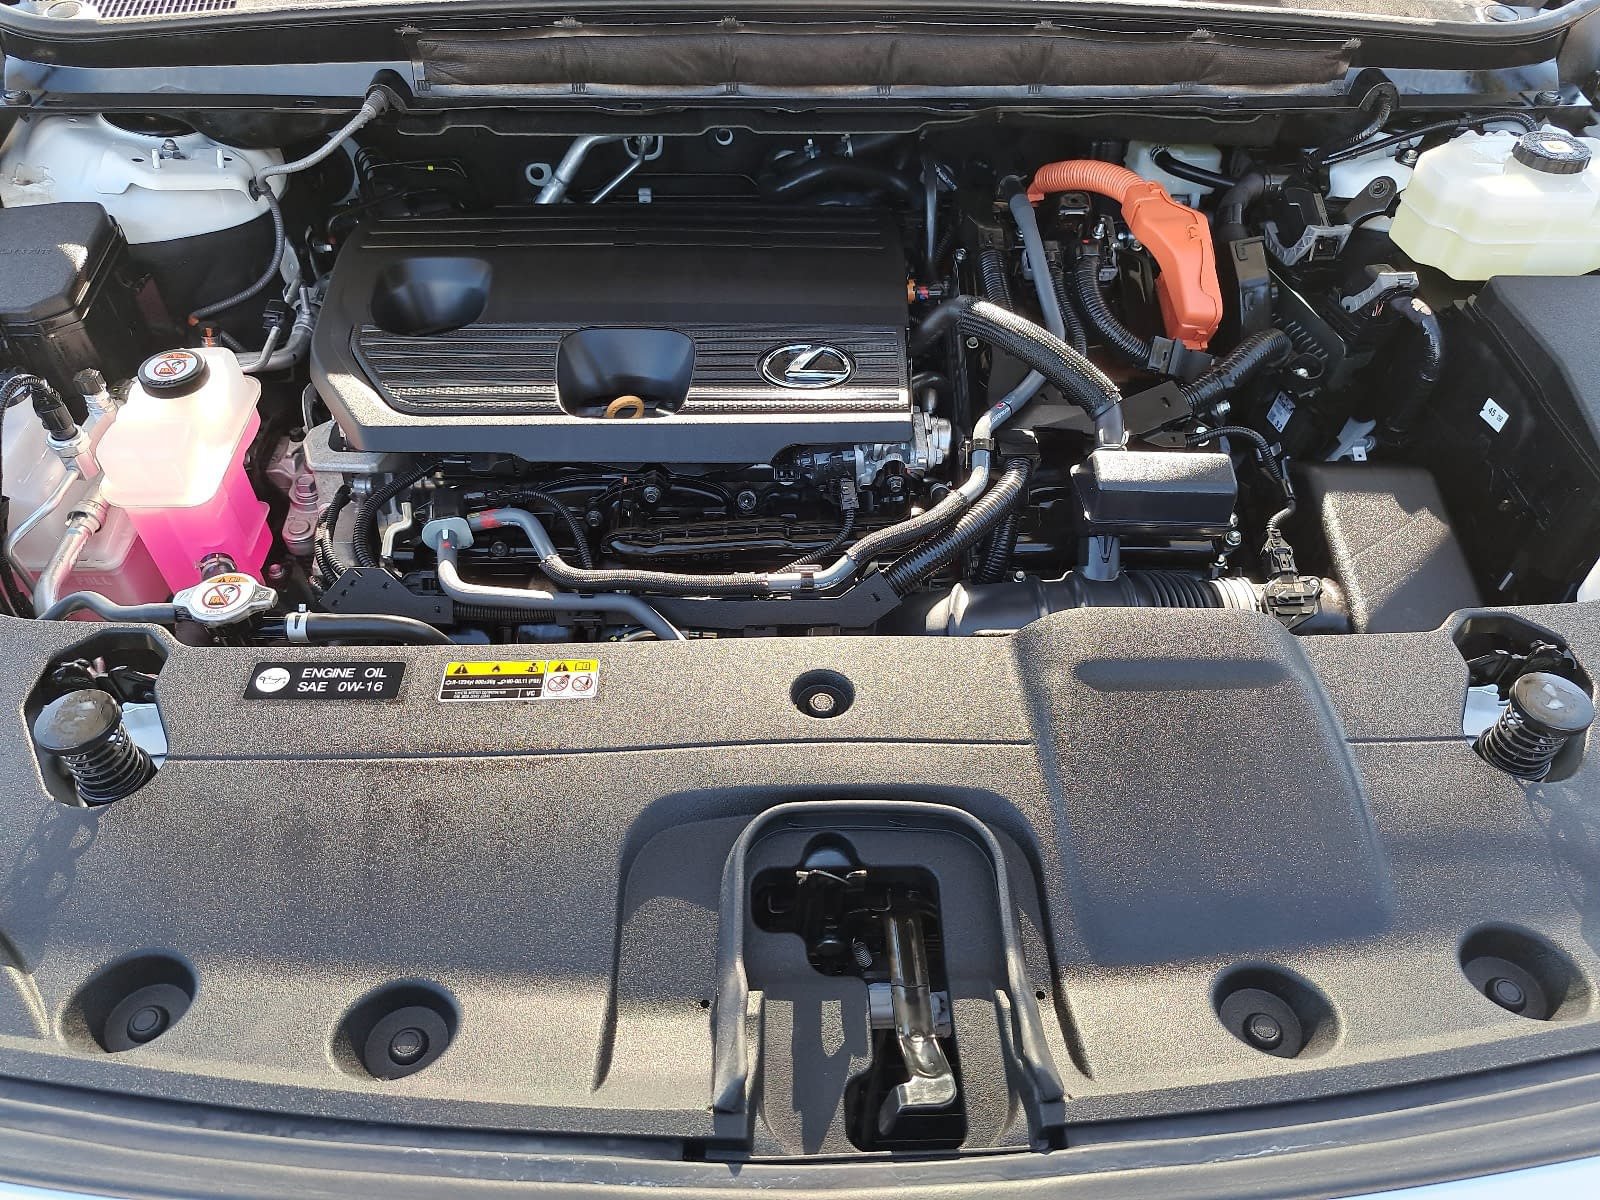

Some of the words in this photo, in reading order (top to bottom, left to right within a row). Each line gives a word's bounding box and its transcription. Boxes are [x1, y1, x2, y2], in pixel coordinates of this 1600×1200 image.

[1488, 407, 1497, 417] 45
[302, 667, 356, 678] ENGINE
[364, 667, 387, 678] OIL
[297, 681, 328, 692] SAE
[337, 681, 384, 692] 0W-16
